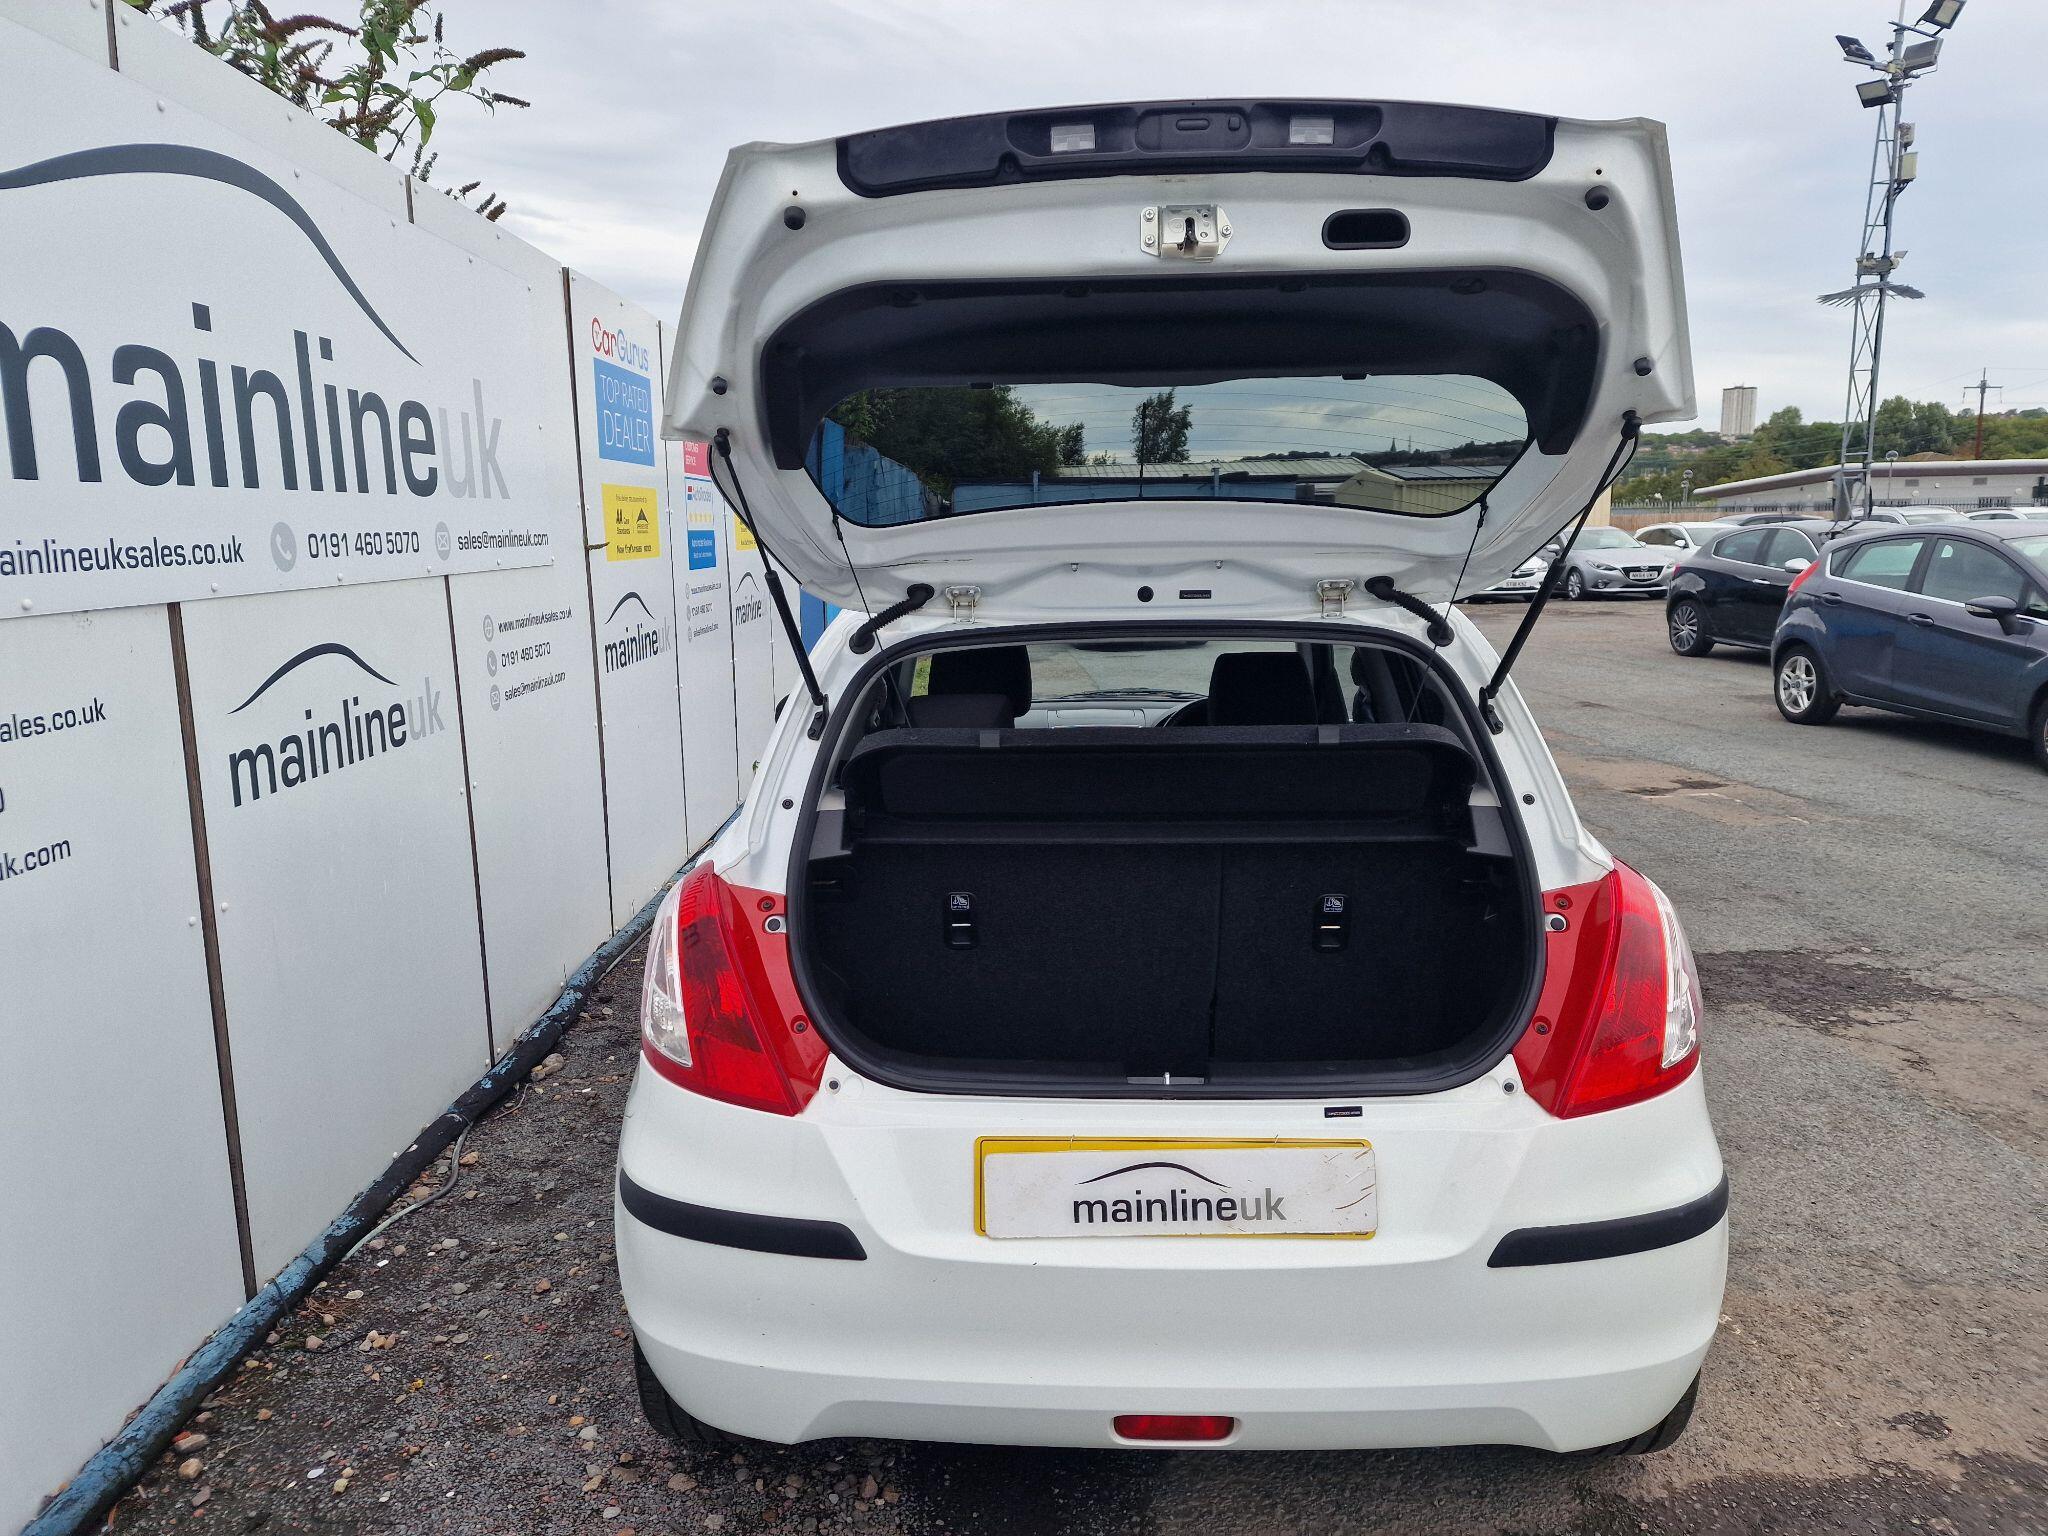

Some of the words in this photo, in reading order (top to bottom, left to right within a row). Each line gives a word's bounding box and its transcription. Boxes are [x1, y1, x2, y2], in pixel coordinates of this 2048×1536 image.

[591, 317, 649, 372] CarGurus
[0, 302, 510, 499] mainlineuk
[600, 374, 620, 404] TOP
[622, 382, 649, 414] RATED
[603, 410, 651, 453] DEALER
[307, 532, 350, 559] 0191
[354, 532, 383, 556] 460
[386, 531, 420, 555] 5070
[457, 529, 549, 551] sales@mainlineuk.com
[735, 590, 768, 627] mainline
[604, 616, 672, 674] mainlineuk
[228, 677, 445, 807] mainlineuk
[1073, 1187, 1287, 1225] mainlineuk
